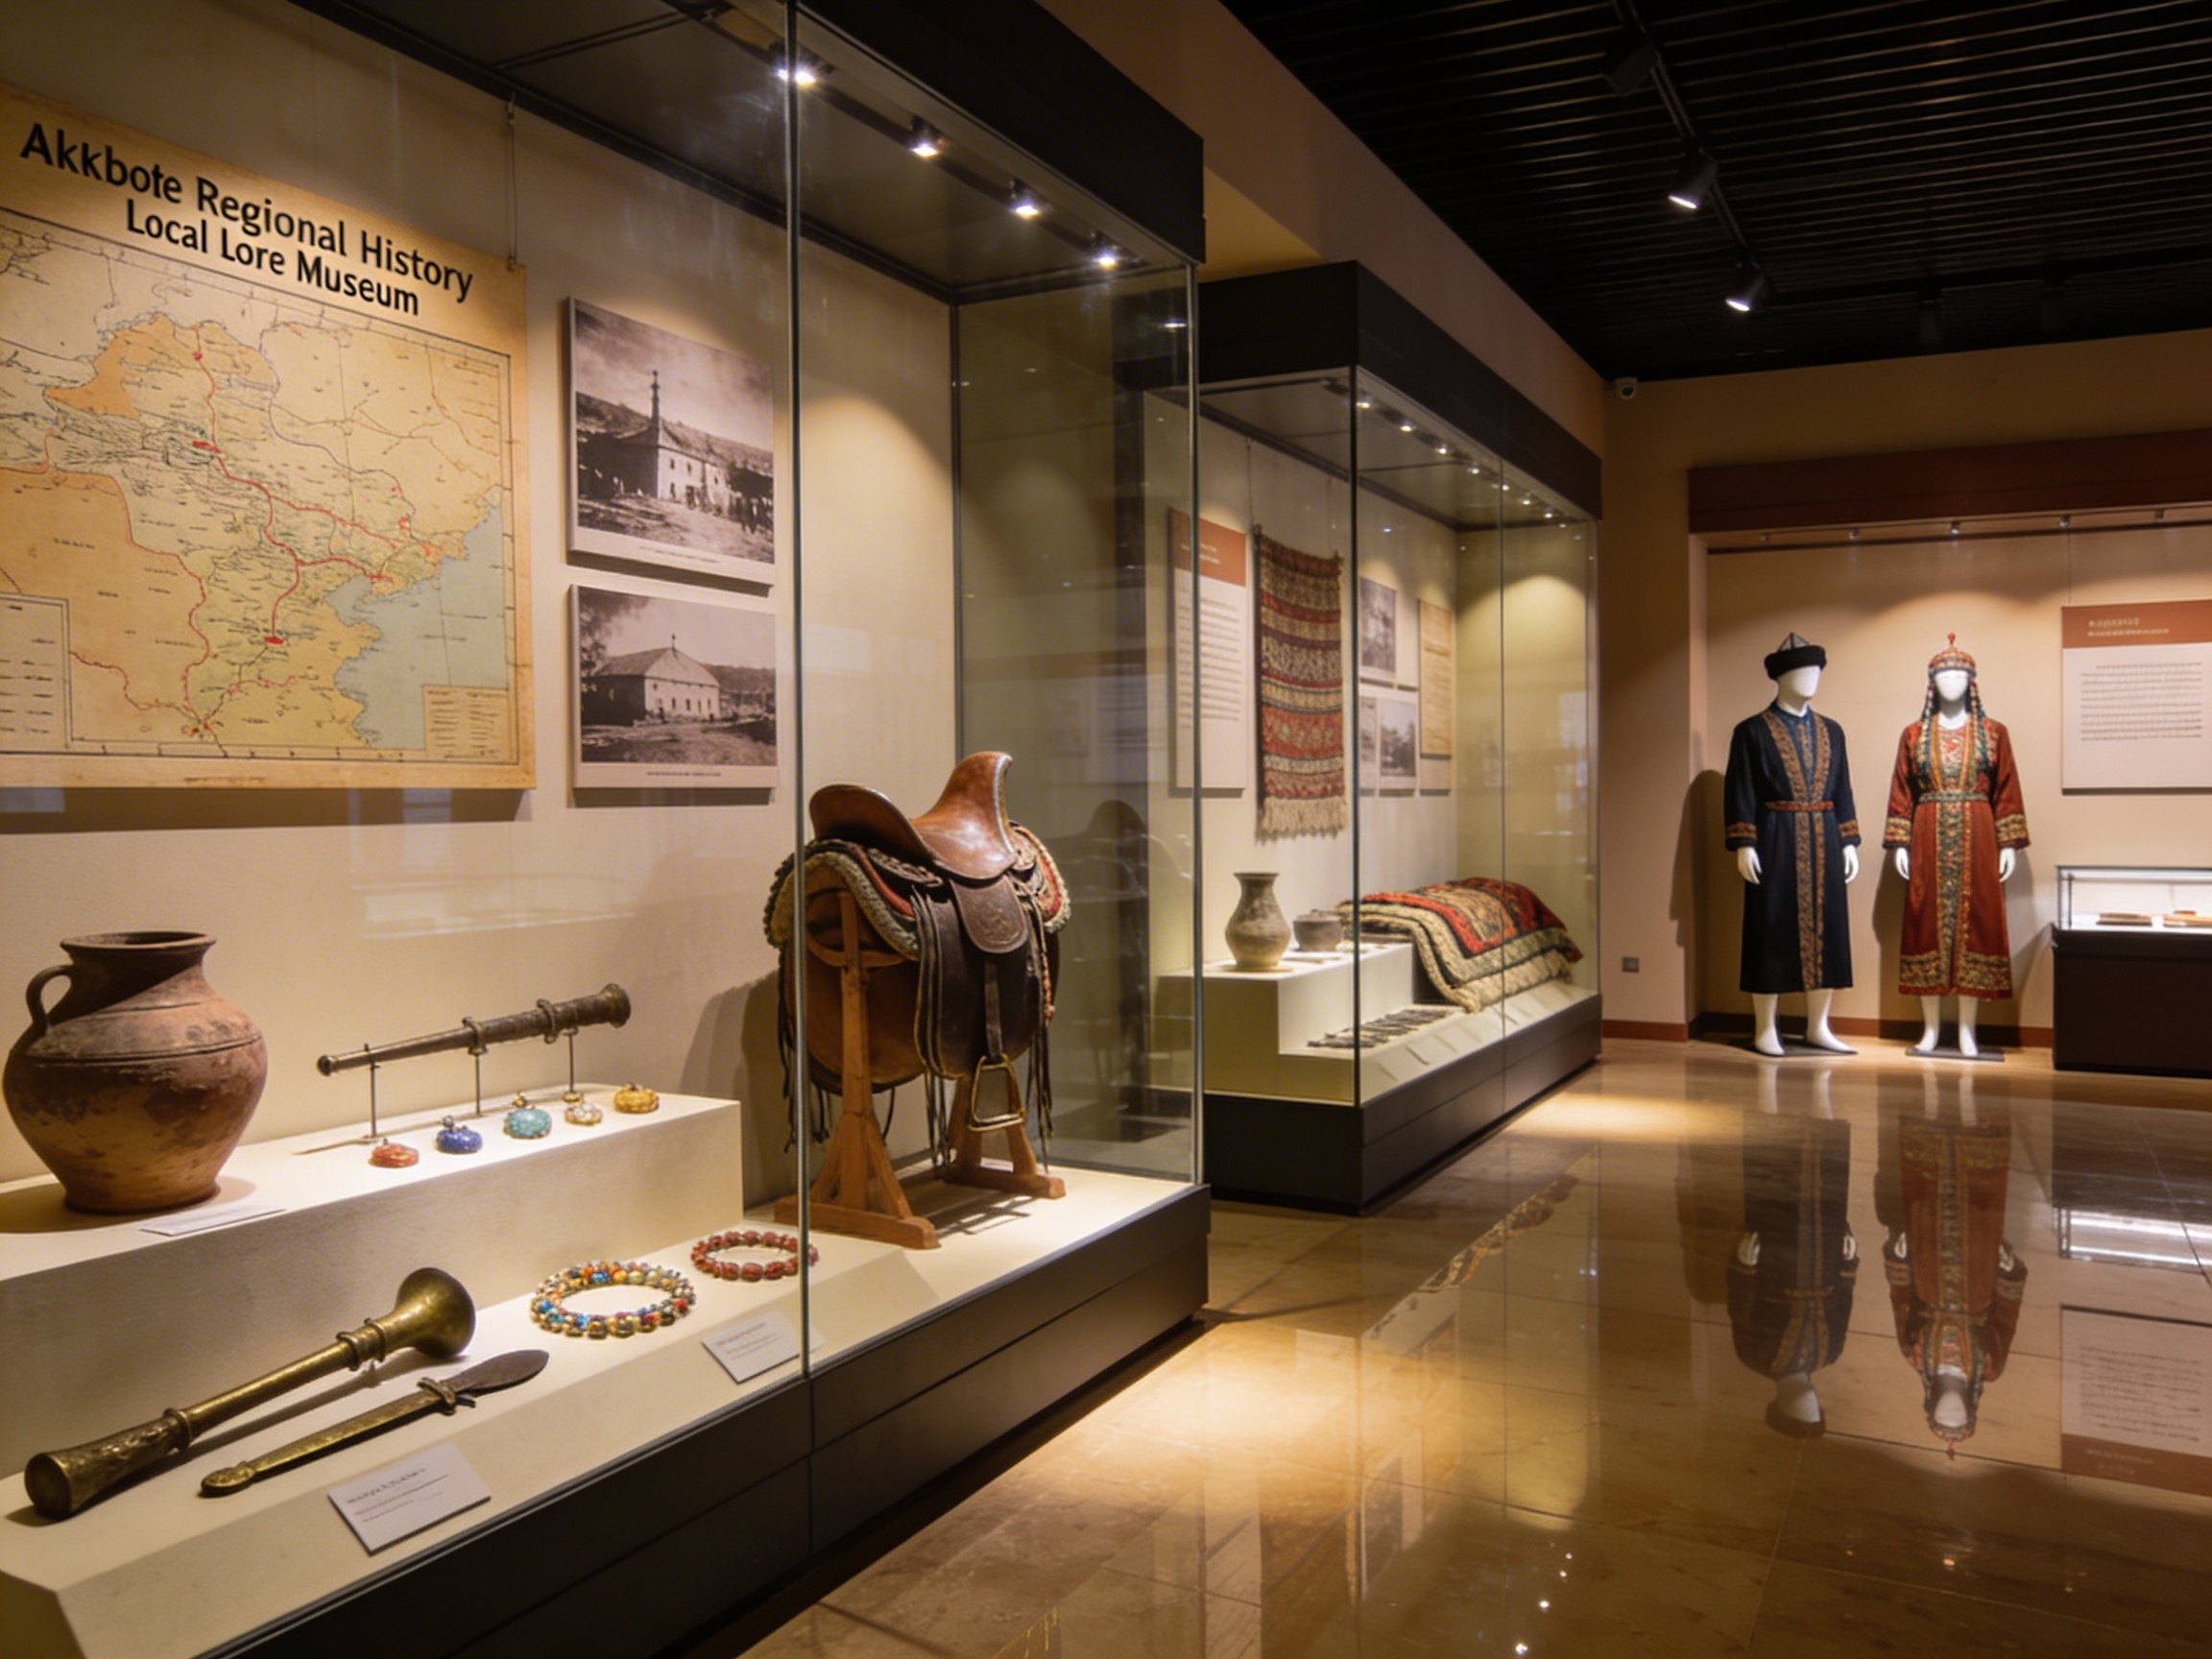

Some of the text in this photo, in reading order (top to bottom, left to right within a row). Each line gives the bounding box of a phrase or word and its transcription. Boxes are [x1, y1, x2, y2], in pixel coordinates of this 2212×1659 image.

[20, 122, 473, 303] Akkbote Regional History
[126, 198, 420, 316] Local Lore Museum
